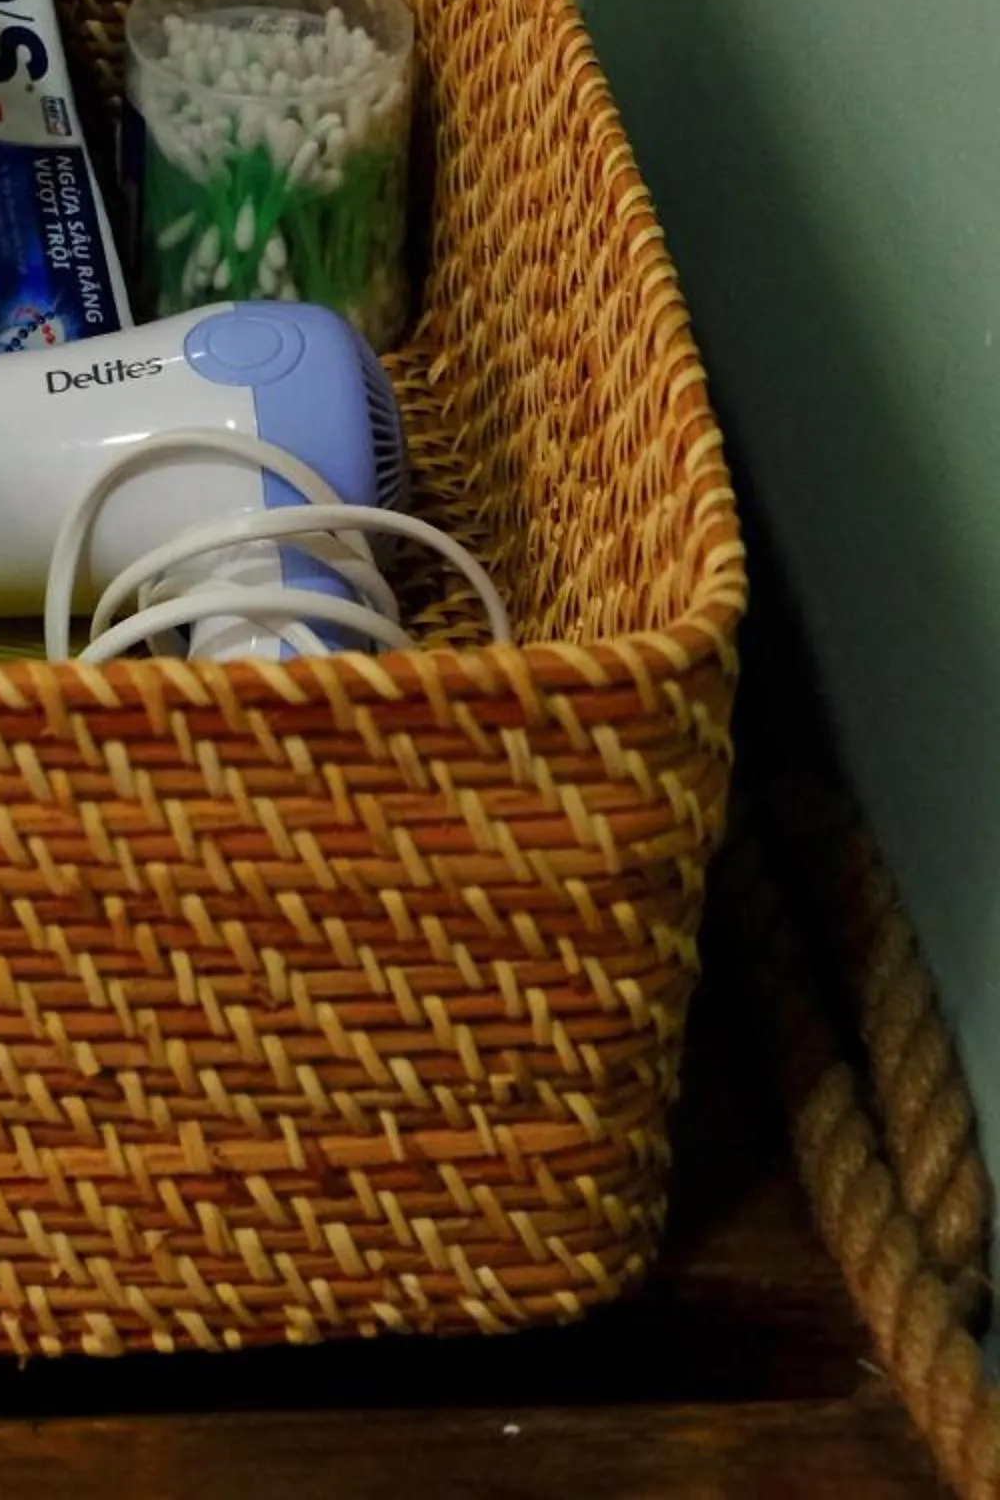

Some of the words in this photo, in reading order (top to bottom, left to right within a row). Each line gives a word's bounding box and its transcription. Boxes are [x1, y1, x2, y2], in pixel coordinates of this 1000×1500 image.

[45, 221, 73, 269] TRỘI
[67, 220, 92, 259] SÂU
[46, 357, 163, 394] Delites
